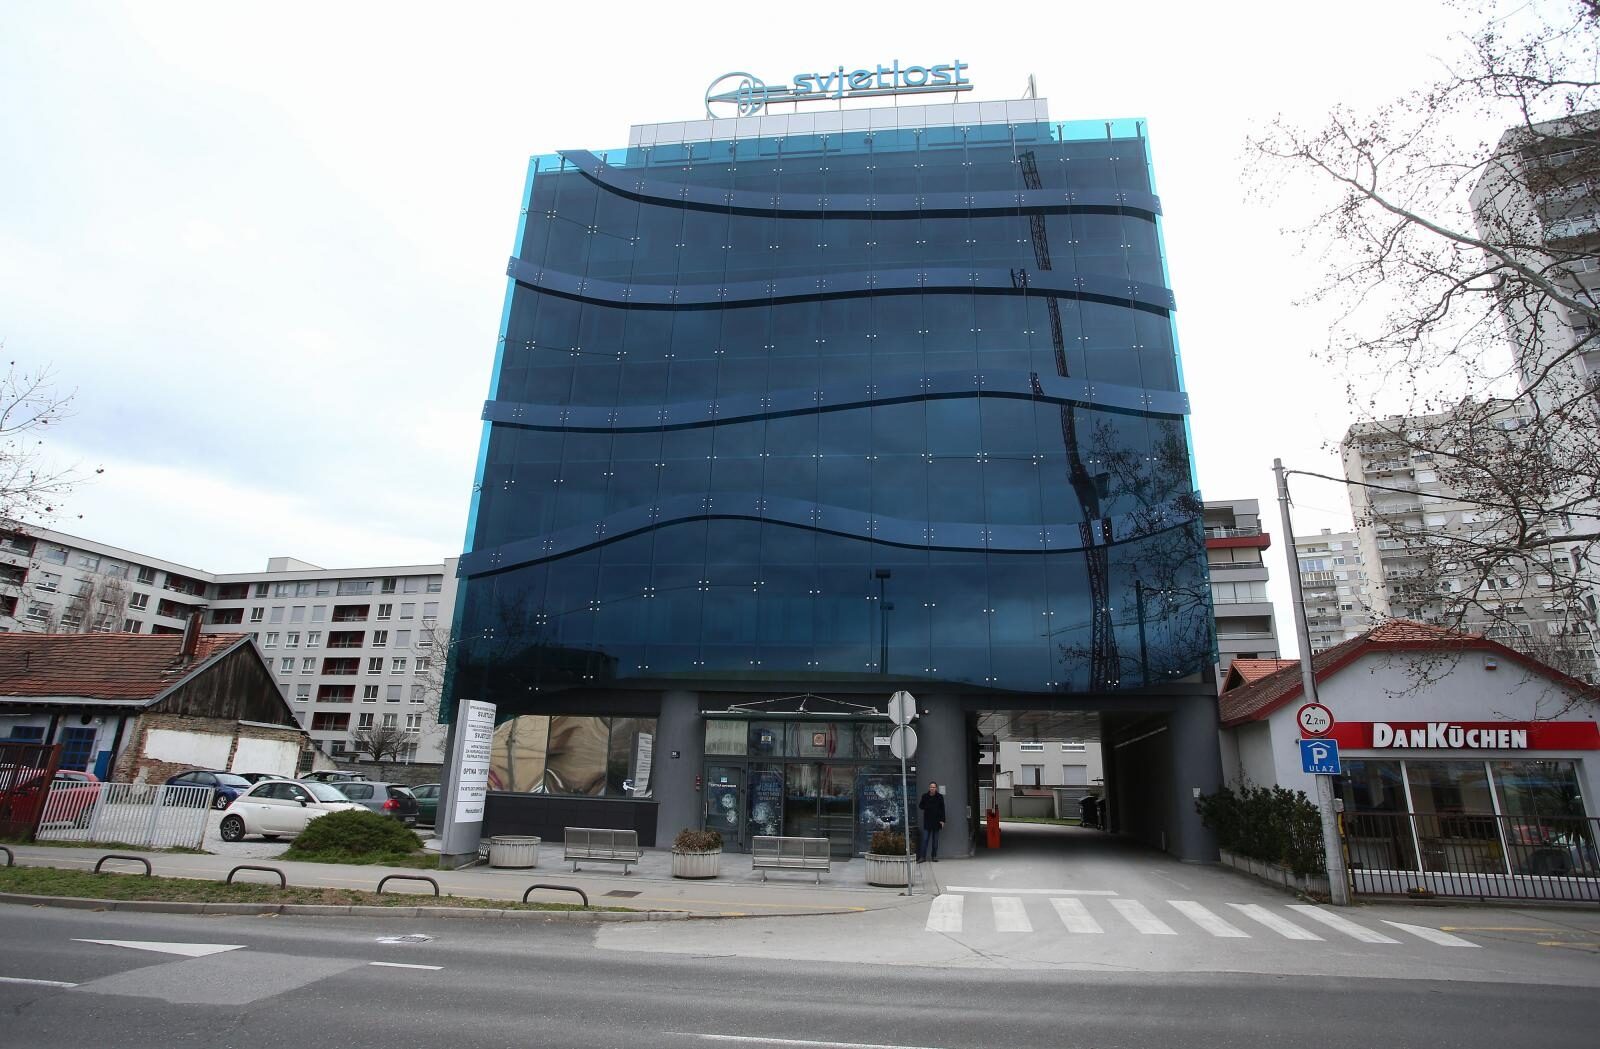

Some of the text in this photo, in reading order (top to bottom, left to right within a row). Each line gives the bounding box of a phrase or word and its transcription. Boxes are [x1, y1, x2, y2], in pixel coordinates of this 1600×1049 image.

[793, 59, 969, 100] svjetlost
[1312, 747, 1328, 765] P
[1308, 765, 1335, 773] ULAZ
